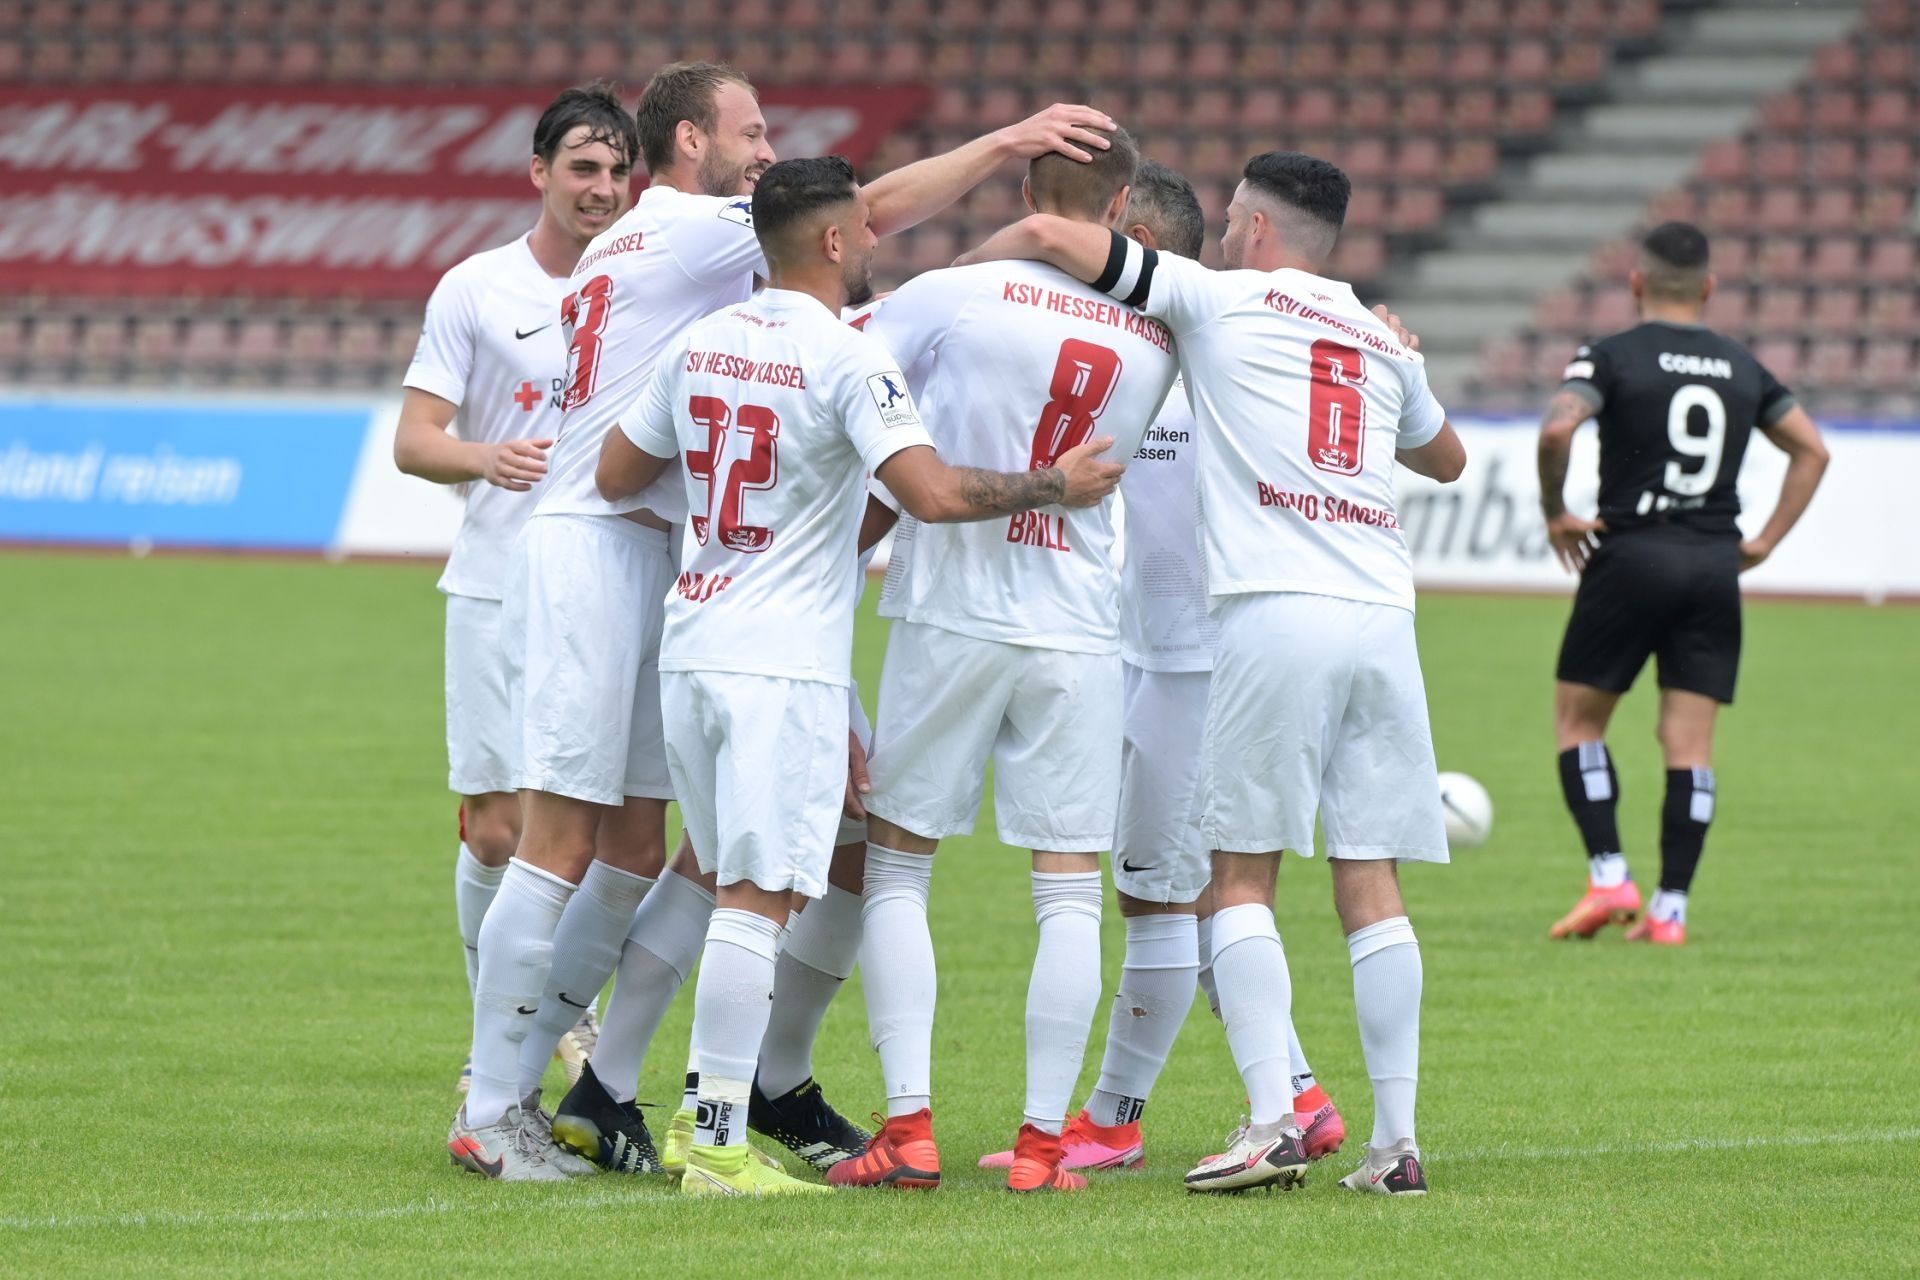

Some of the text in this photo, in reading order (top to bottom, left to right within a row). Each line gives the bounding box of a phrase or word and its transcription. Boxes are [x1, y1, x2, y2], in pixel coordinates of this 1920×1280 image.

[1003, 281, 1173, 355] KSV HESSEN KASSEL
[1264, 288, 1300, 315] KSV
[753, 362, 807, 390] KASSEL
[1658, 352, 1733, 380] COBAN
[1030, 337, 1123, 472] 8
[1307, 338, 1368, 477] 6
[1146, 427, 1190, 443] niken
[1663, 384, 1727, 495] 9
[686, 395, 780, 554] 32
[1007, 511, 1071, 552] BRILL
